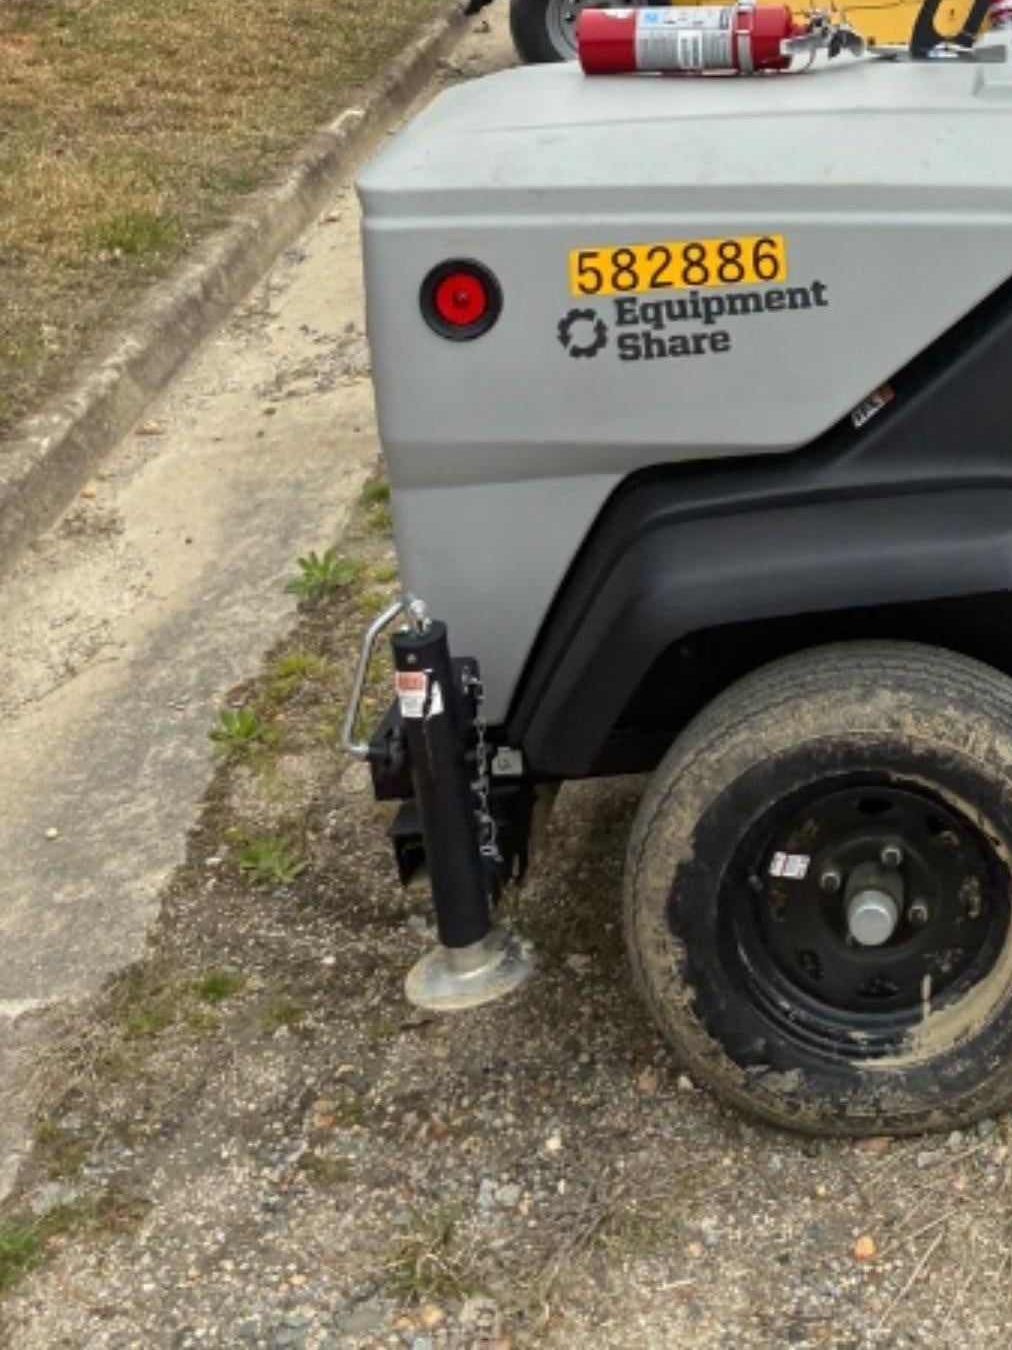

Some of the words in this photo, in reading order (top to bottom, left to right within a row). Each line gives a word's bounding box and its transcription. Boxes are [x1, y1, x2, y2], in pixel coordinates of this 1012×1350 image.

[577, 236, 780, 295] 582886
[613, 289, 829, 330] Equipment
[617, 330, 731, 361] Share
